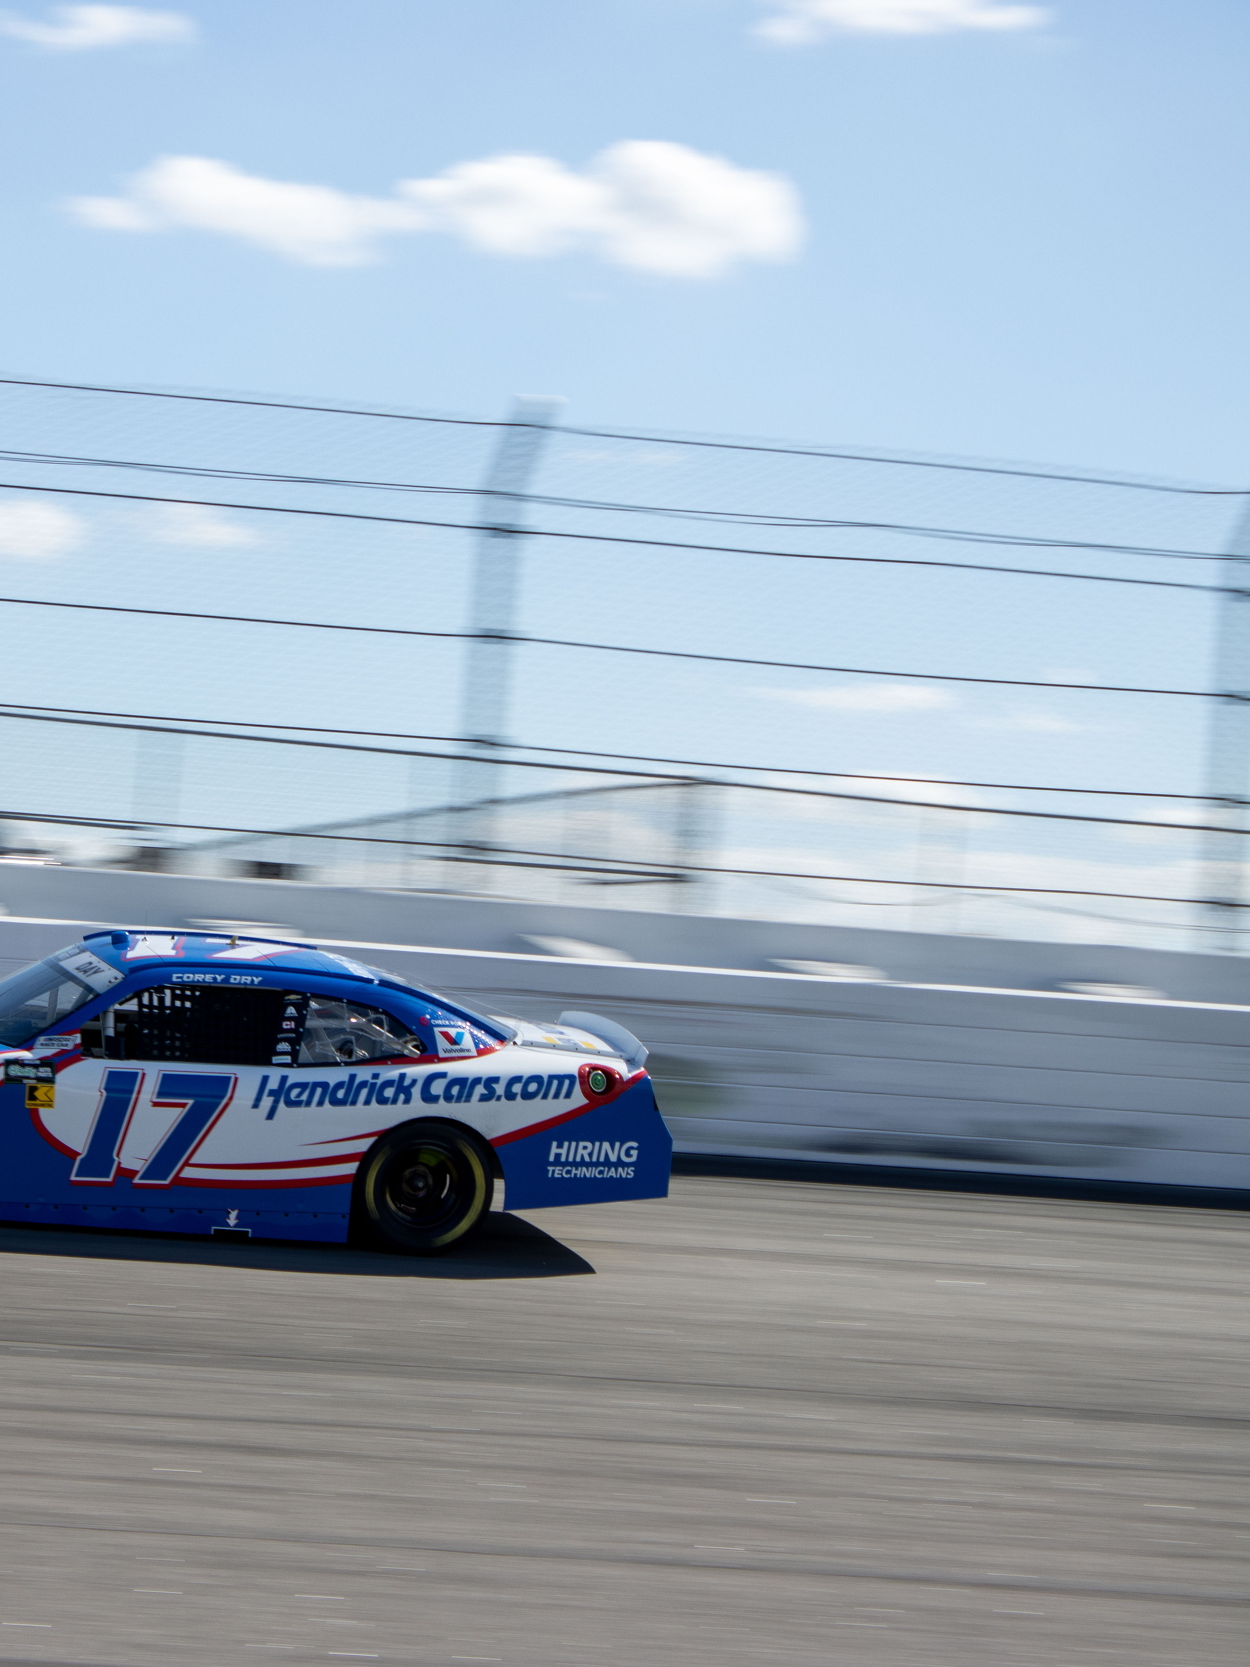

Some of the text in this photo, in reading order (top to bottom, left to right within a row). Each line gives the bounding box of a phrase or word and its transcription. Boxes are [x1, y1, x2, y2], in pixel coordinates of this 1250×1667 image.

[121, 935, 303, 962] 17
[74, 961, 105, 977] DAY
[172, 973, 263, 985] COREY DAY
[69, 1067, 238, 1190] 17
[549, 1141, 639, 1162] HIRING
[547, 1166, 635, 1178] TECHNICIANS
